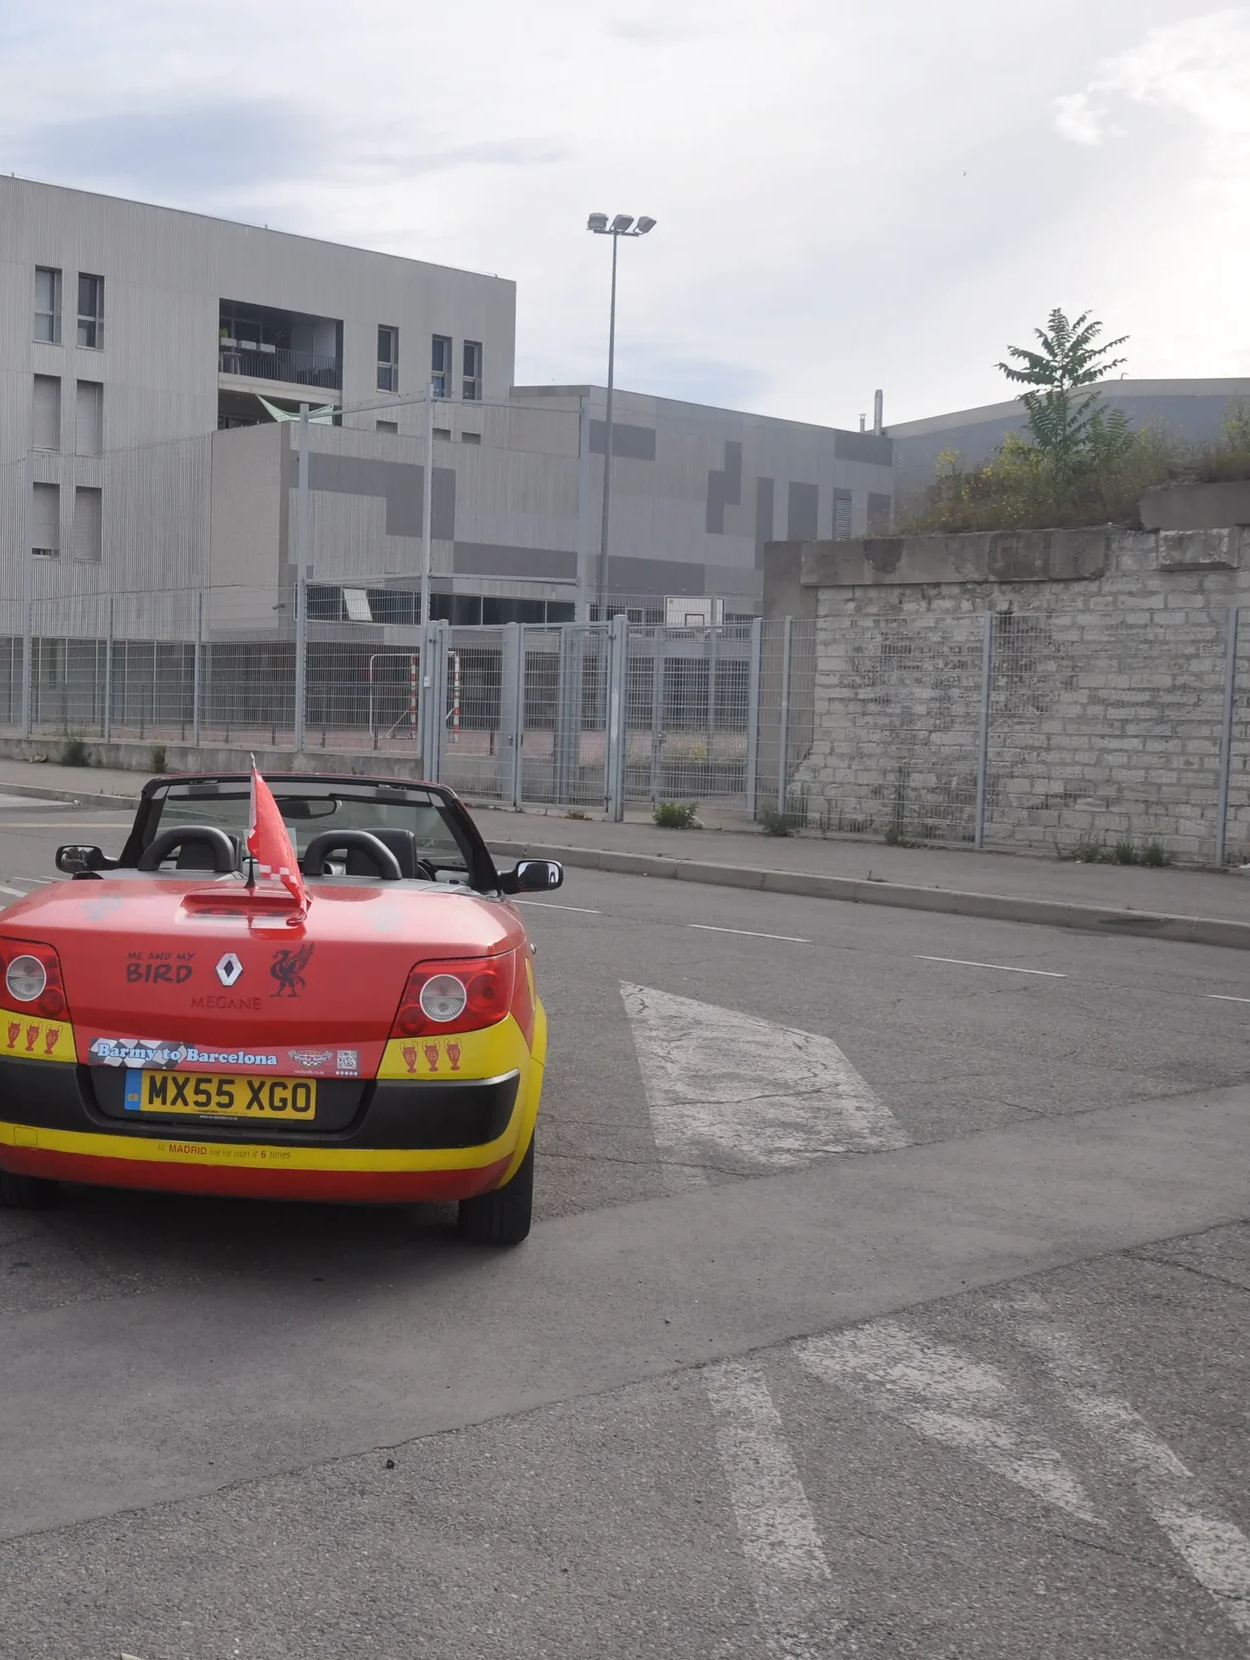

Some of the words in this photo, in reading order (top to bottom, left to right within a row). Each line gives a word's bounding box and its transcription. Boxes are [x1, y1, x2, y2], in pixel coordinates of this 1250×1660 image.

[128, 952, 143, 960] ME
[148, 952, 172, 961] AND
[176, 952, 196, 962] MY
[126, 963, 194, 984] BIRD
[190, 995, 262, 1011] MEGANE
[97, 1043, 158, 1061] Barmy
[161, 1047, 182, 1061] to
[186, 1048, 278, 1066] Barcelona
[406, 1053, 416, 1061] 84
[427, 1052, 438, 1060] 05
[449, 1050, 459, 1058] 19
[148, 1075, 235, 1108] MX55
[245, 1079, 312, 1112] XGO
[168, 1144, 207, 1155] MADRID
[234, 1150, 251, 1158] won
[251, 1150, 258, 1158] it
[260, 1150, 267, 1159] 6
[269, 1150, 291, 1159] times
